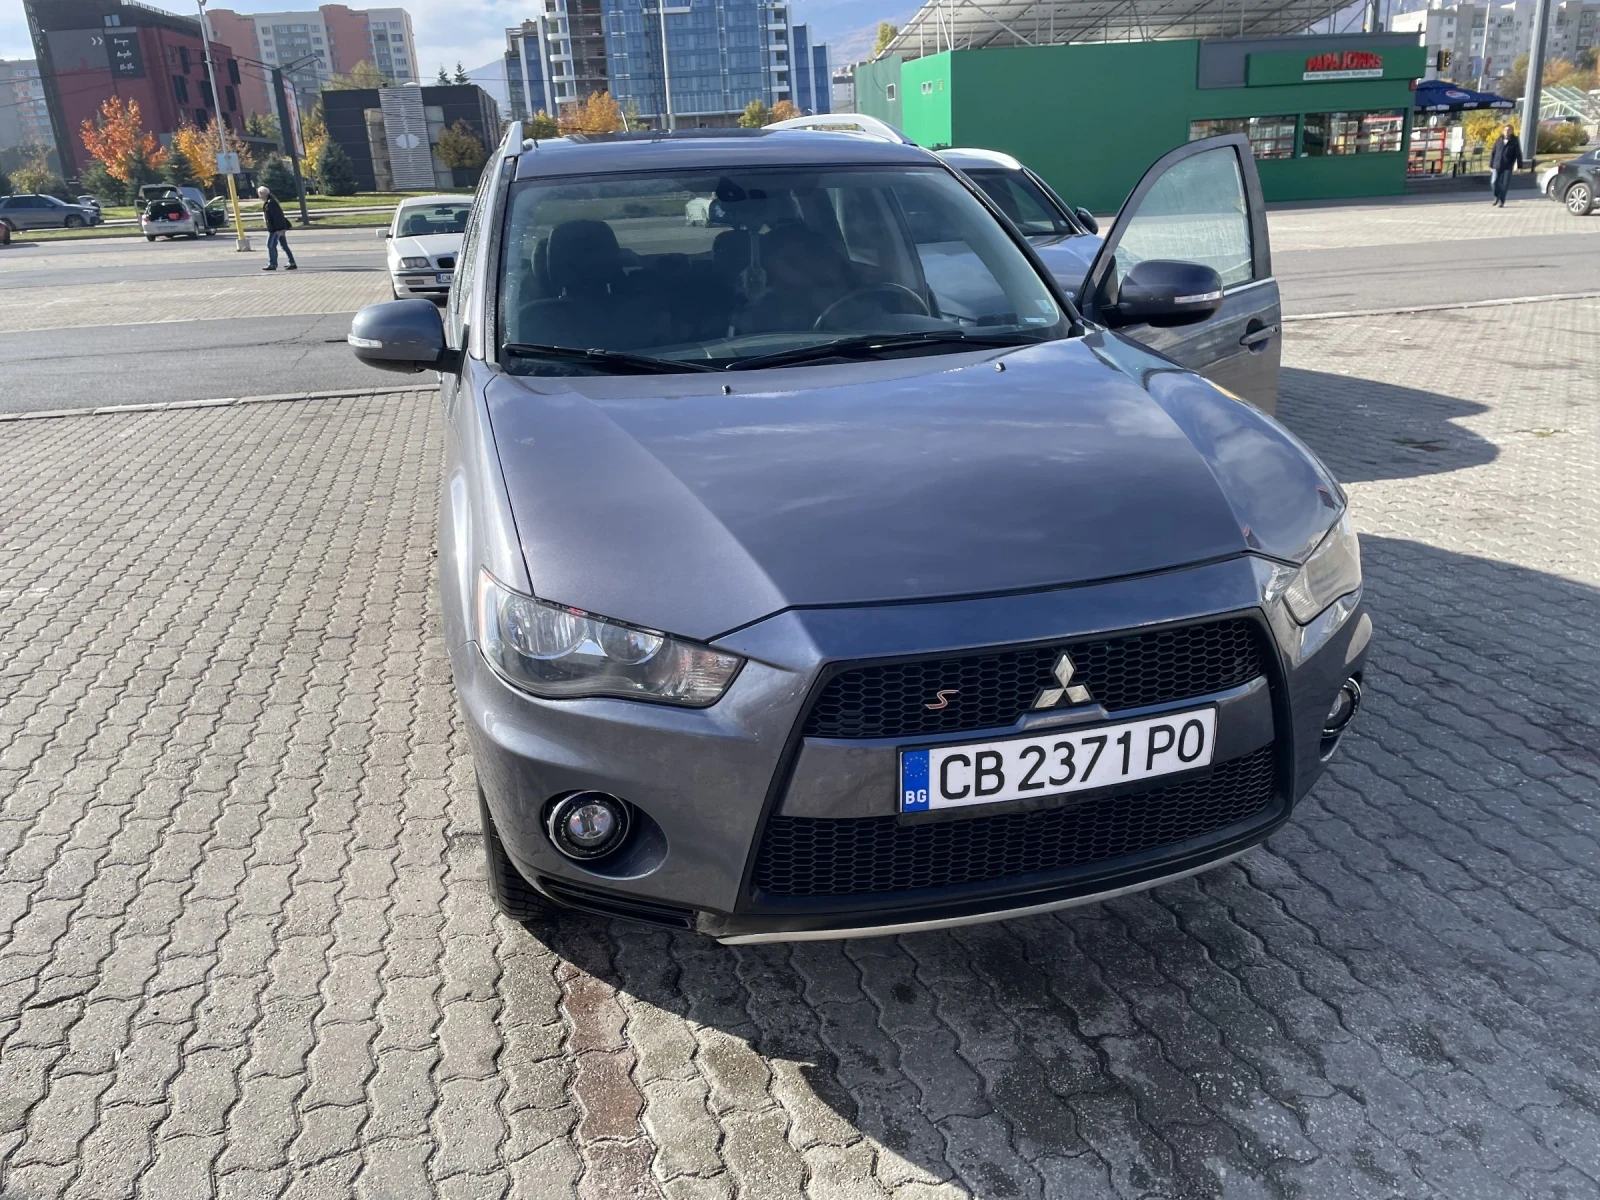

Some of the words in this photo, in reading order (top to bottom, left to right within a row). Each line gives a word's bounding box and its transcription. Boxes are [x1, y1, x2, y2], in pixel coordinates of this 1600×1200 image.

[1307, 53, 1340, 71] PAPA
[1341, 51, 1383, 69] JOHNS
[924, 689, 959, 709] S
[939, 750, 1006, 800] CB
[1017, 730, 1132, 792] 2371
[1145, 718, 1205, 771] PO
[905, 788, 928, 805] BG
